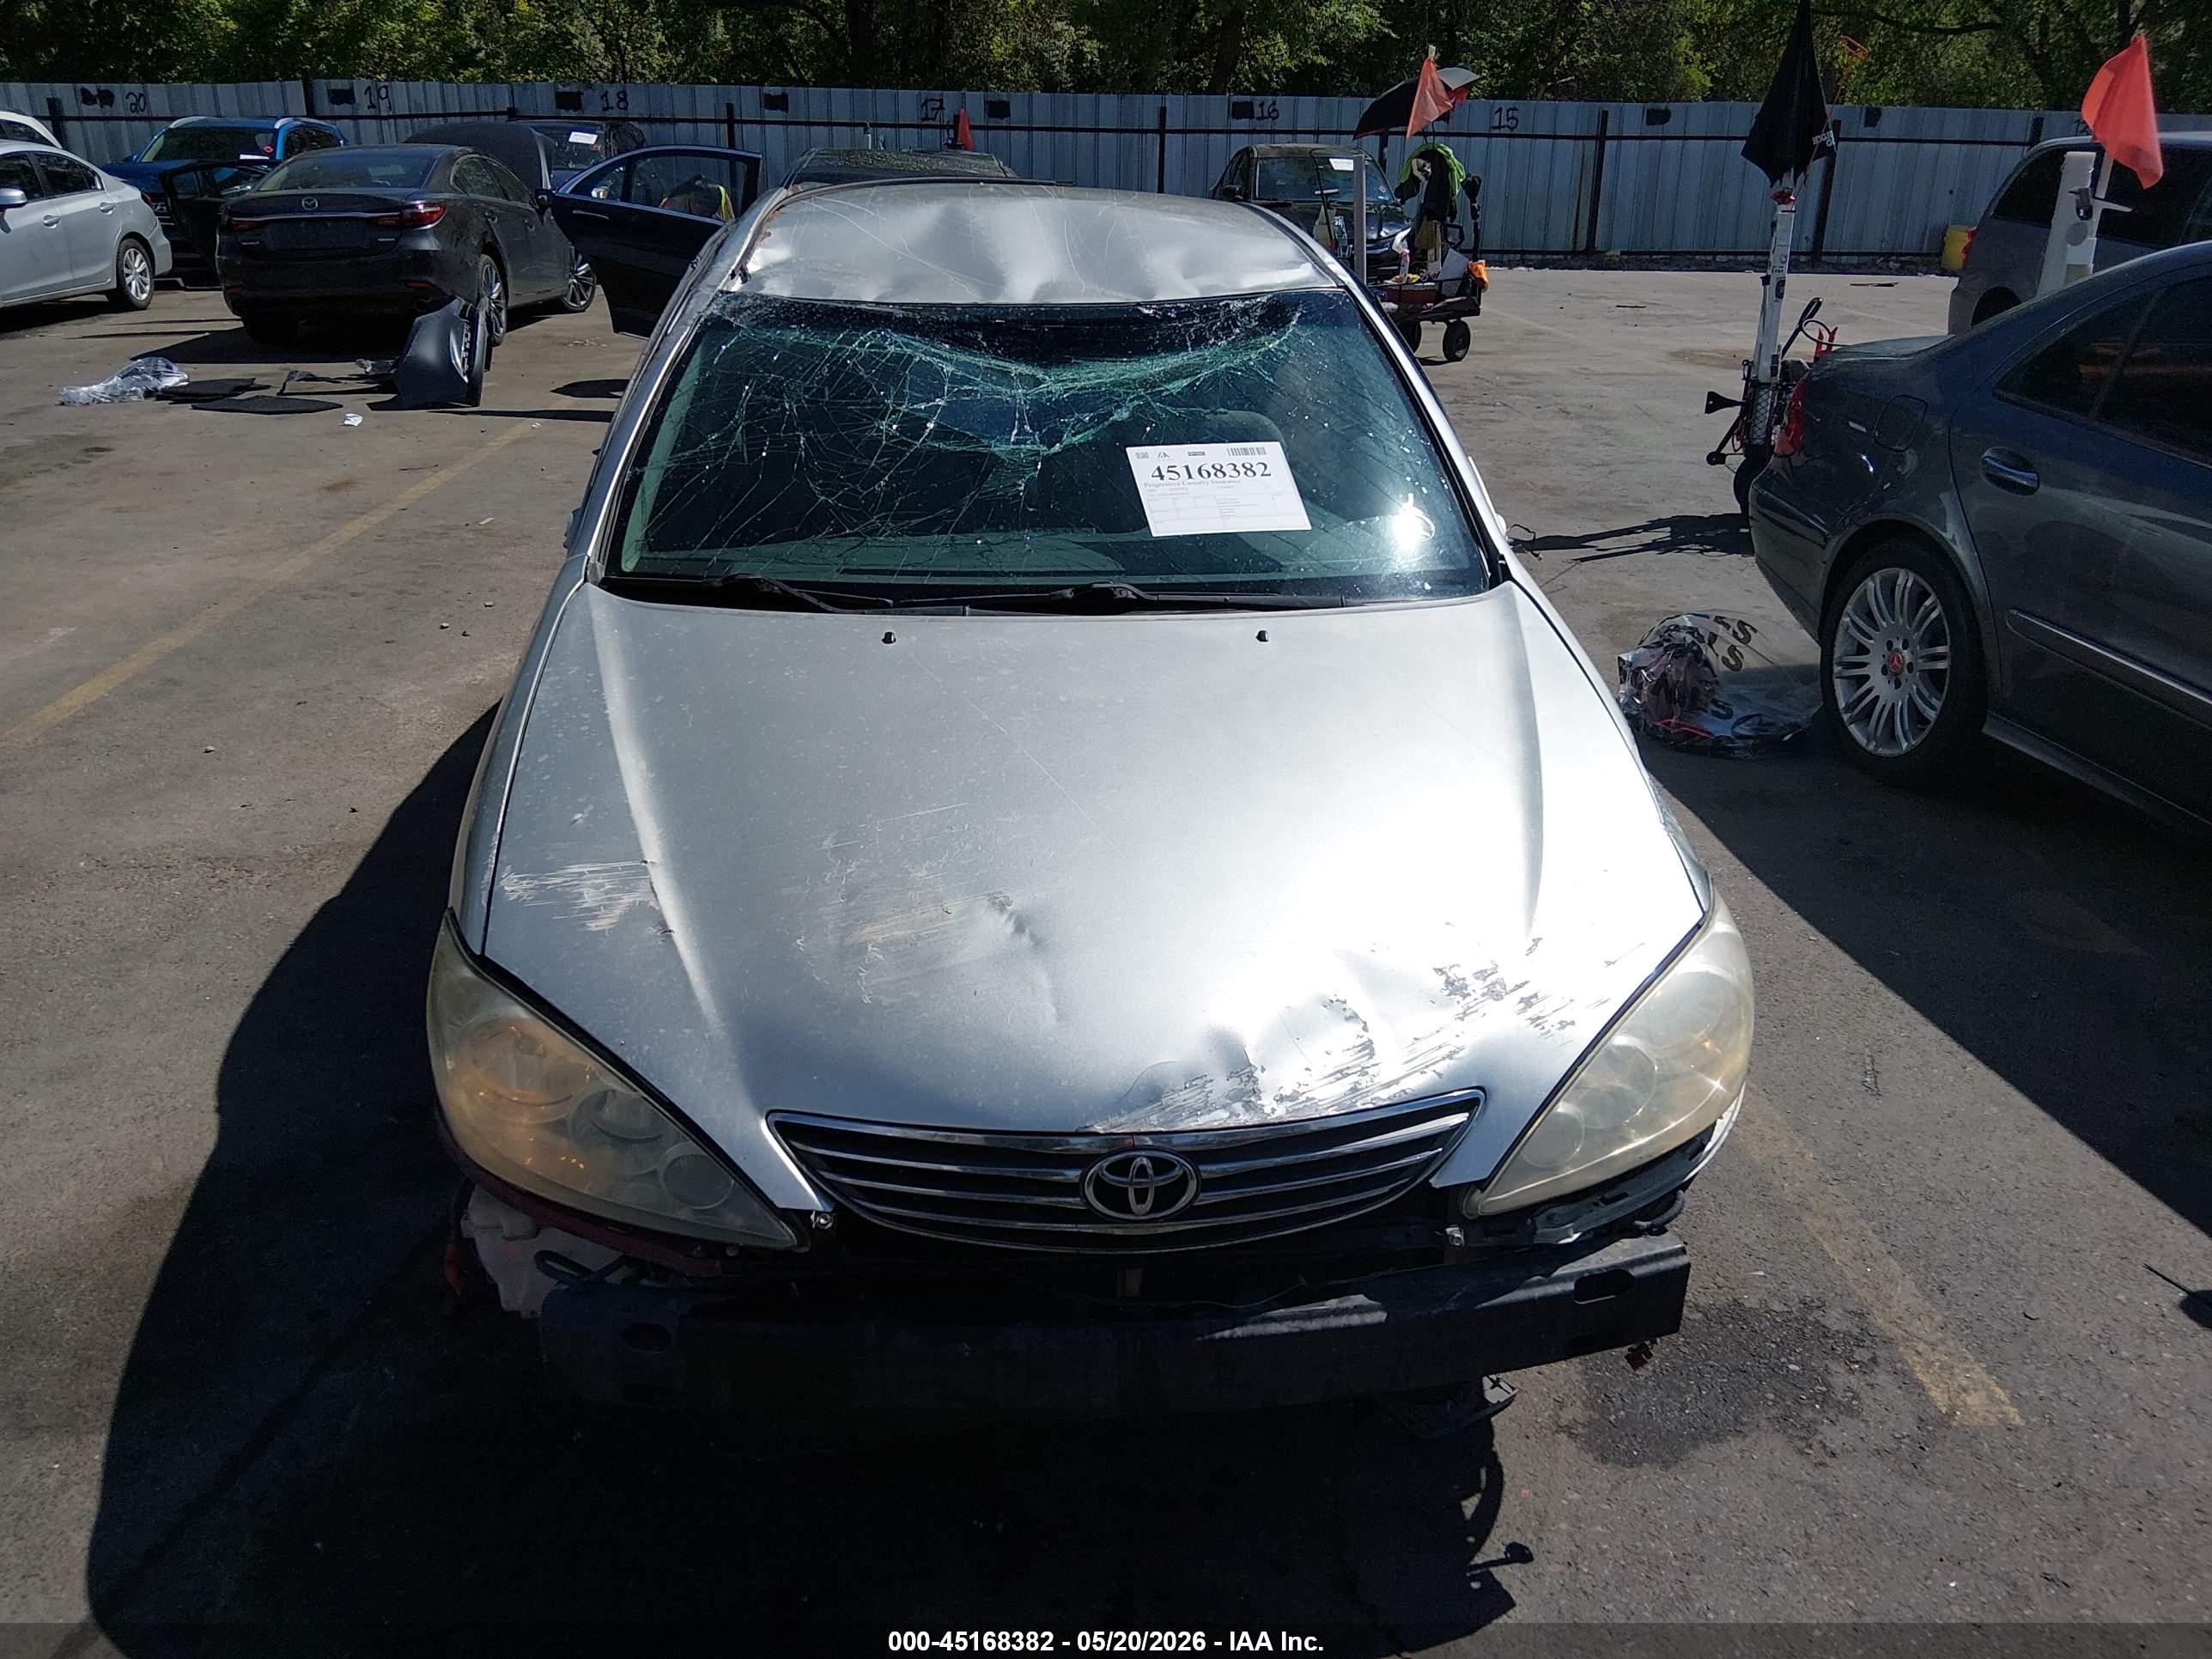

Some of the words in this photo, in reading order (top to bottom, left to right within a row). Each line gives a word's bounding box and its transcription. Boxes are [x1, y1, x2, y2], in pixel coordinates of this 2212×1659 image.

[125, 92, 146, 113] 20
[364, 85, 392, 112] 19
[600, 90, 629, 111] 18
[921, 97, 945, 121] 17
[1256, 100, 1279, 120] 16
[1491, 106, 1519, 131] 15
[1151, 461, 1272, 481] 45168382
